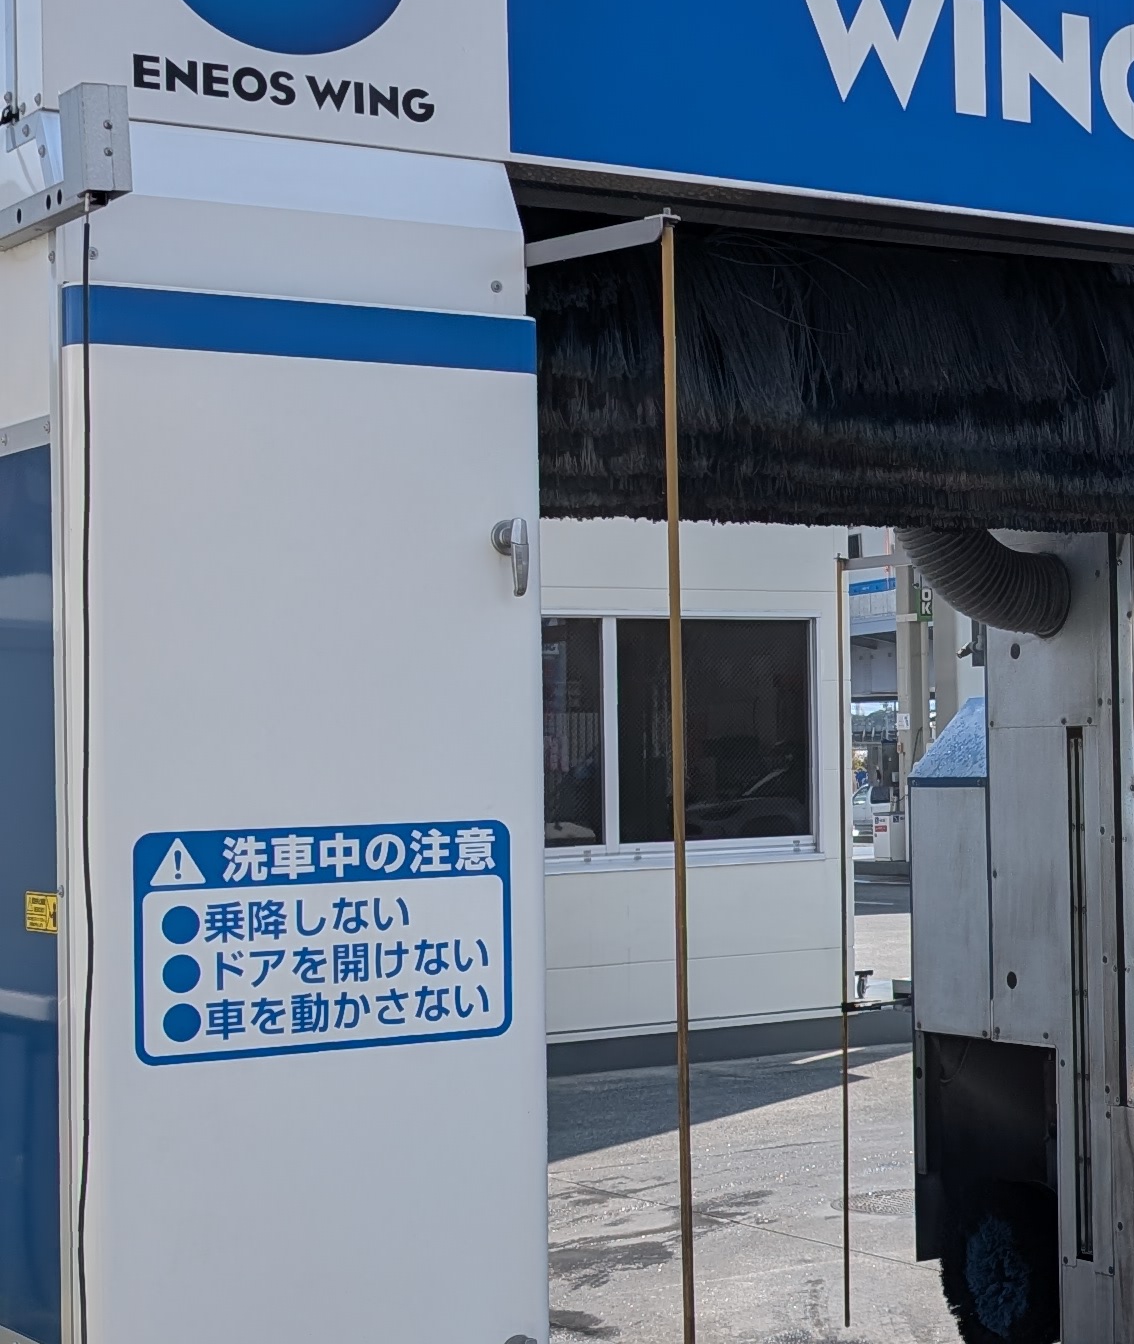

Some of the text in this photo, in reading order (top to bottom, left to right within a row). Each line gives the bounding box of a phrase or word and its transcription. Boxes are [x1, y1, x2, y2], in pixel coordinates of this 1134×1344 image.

[132, 52, 436, 124] ENEOS WING
[222, 826, 497, 883] 洗車中の注意
[203, 896, 410, 944] 乗降しない
[214, 938, 490, 992] ドアを開けない
[205, 984, 490, 1041] 車を動かさない
